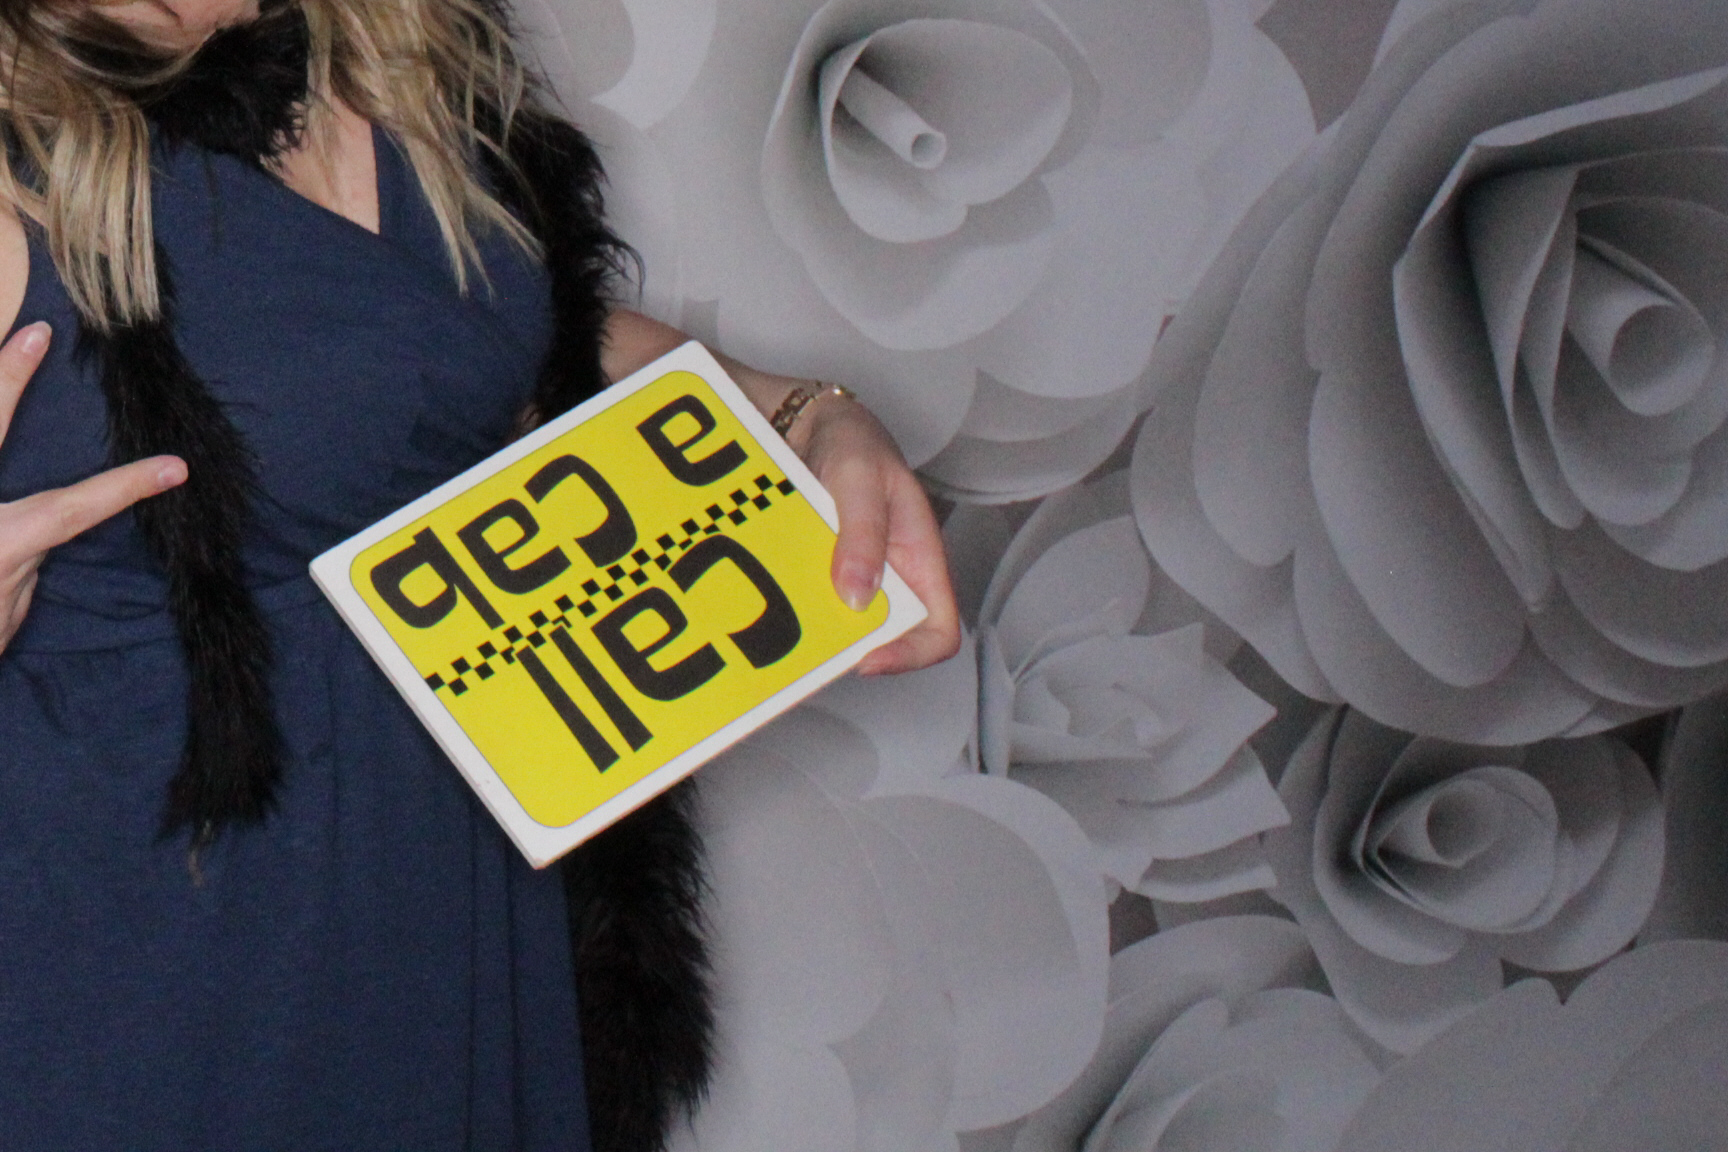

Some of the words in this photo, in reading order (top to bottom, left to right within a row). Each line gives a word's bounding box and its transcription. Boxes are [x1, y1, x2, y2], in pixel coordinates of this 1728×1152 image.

[636, 394, 749, 487] a
[370, 454, 638, 630] Cab
[515, 534, 802, 774] Call
